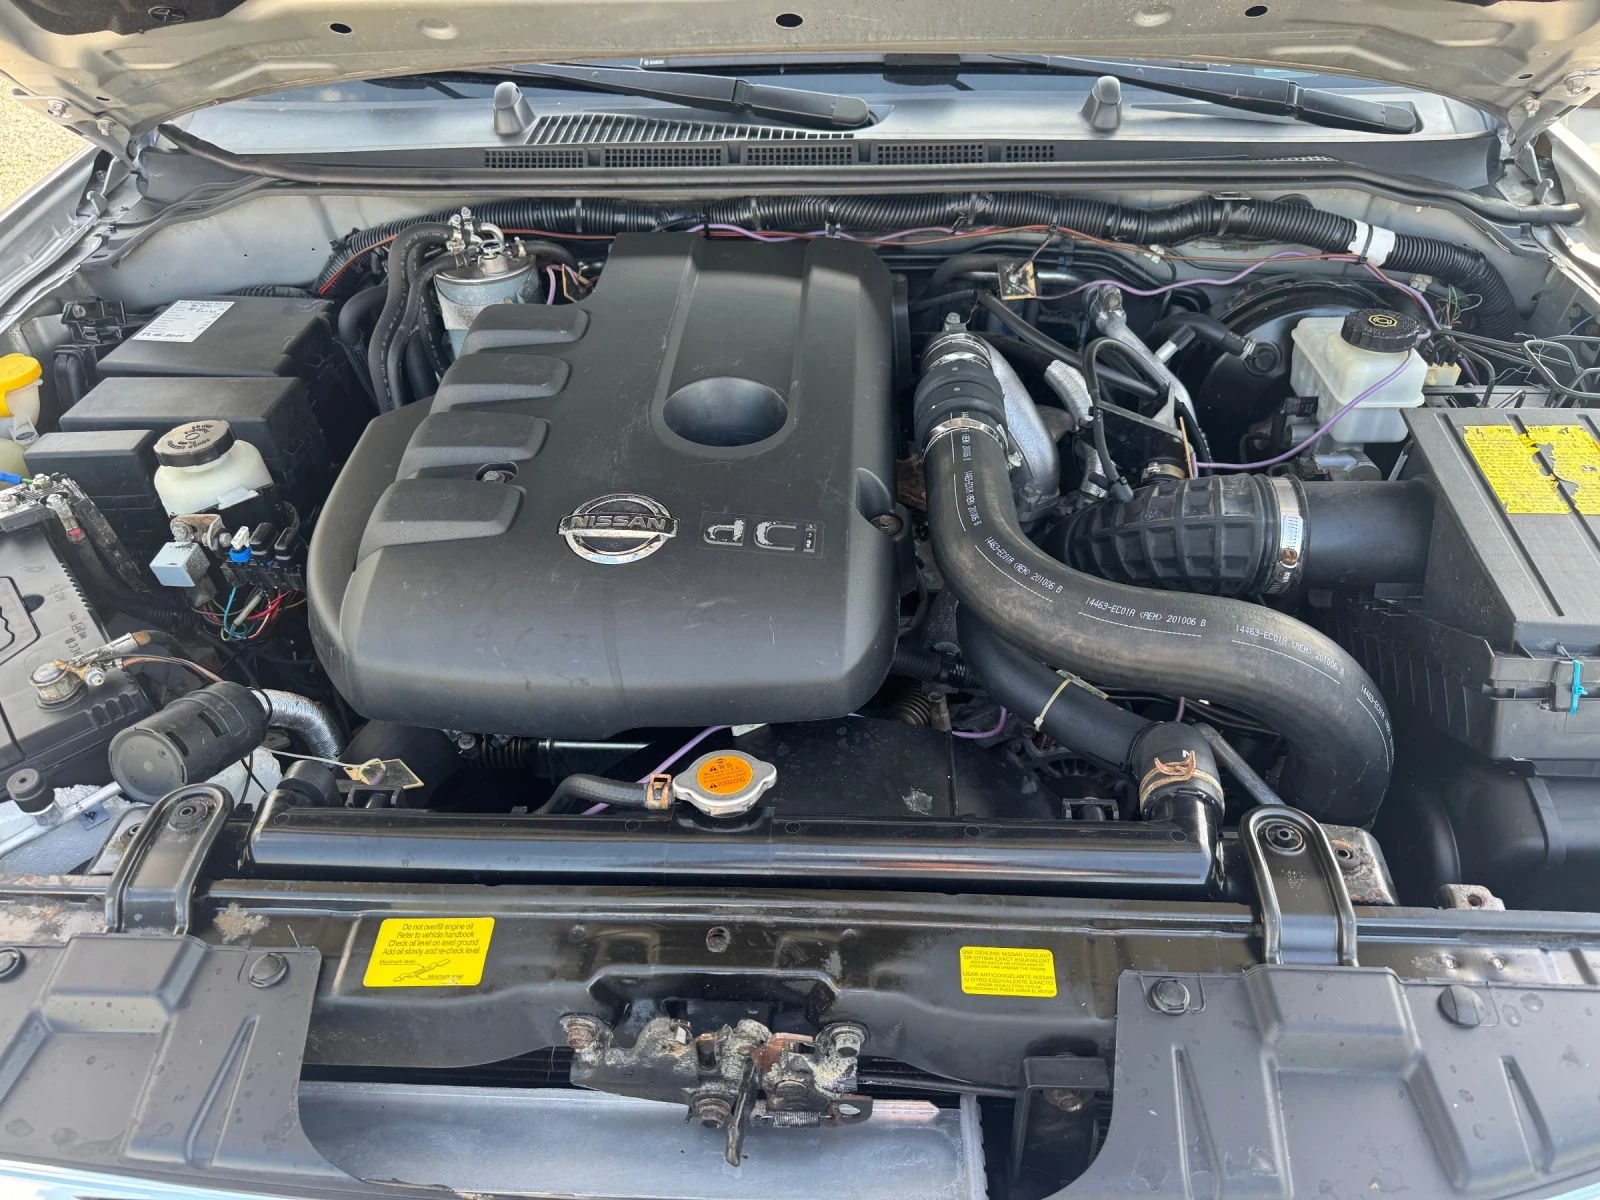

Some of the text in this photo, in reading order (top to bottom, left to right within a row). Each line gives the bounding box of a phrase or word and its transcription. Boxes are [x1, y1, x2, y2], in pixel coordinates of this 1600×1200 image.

[570, 517, 666, 530] NISSAN
[1030, 573, 1055, 590] 201006
[1056, 585, 1063, 593] B
[1166, 615, 1196, 625] 201006
[1316, 652, 1337, 670] 201006
[1339, 667, 1344, 675] B
[456, 939, 479, 947] ground
[404, 948, 423, 956] slowly
